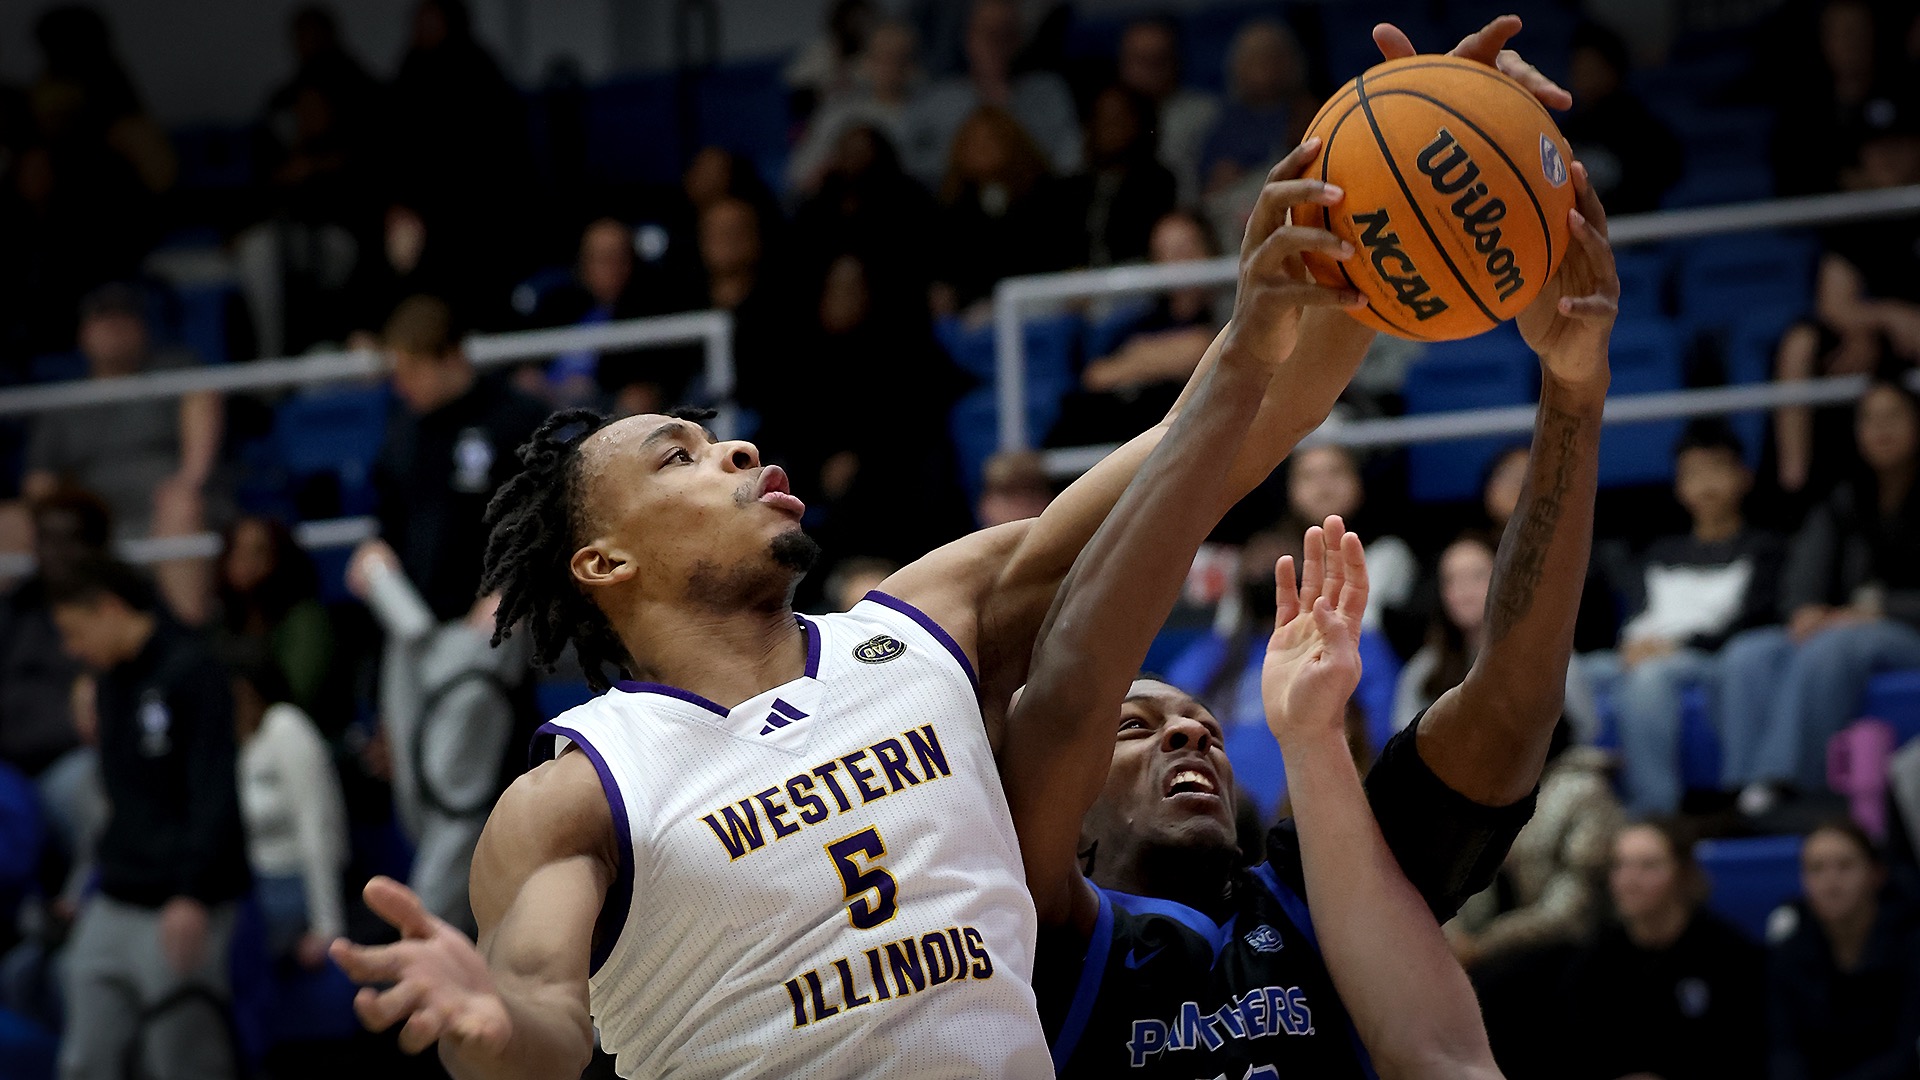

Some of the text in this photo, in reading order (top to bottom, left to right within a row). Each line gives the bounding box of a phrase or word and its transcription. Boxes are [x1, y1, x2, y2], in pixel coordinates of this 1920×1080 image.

[1351, 208, 1448, 321] NCAA
[1416, 127, 1524, 302] Wilson
[863, 639, 896, 658] OVC
[699, 723, 952, 862] WESTERN
[824, 825, 899, 930] 5
[783, 926, 994, 1029] ILLINOIS
